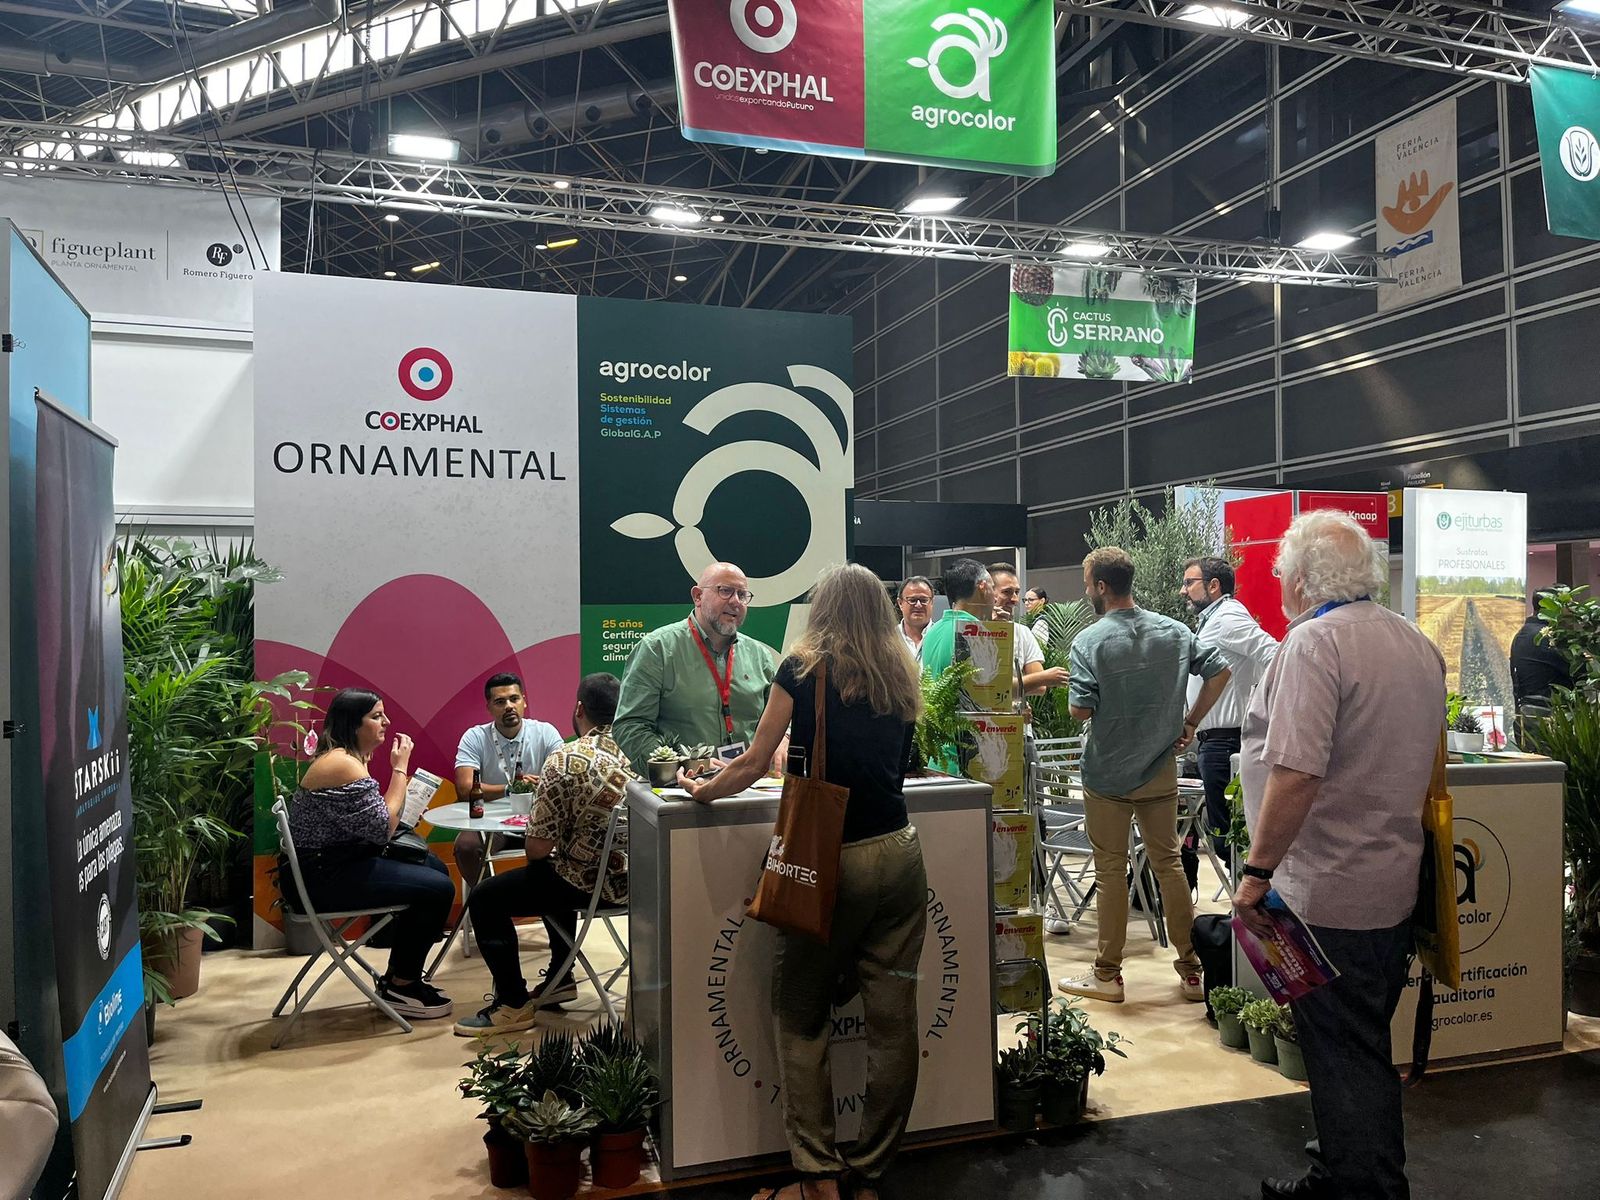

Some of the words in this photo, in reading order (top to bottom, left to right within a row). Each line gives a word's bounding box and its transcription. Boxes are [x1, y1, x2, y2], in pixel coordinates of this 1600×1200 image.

[693, 60, 834, 103] COEXPHAL
[911, 103, 1016, 132] agrocolor
[1396, 135, 1422, 152] FERIA
[1396, 137, 1439, 161] VALENCIA
[51, 236, 156, 262] figueplant
[51, 260, 82, 269] PLANTA
[84, 262, 138, 273] ORNAMENTAL
[183, 268, 218, 279] Romero
[1398, 265, 1425, 280] FERIA
[1398, 269, 1442, 289] VALENCIA
[1073, 311, 1112, 322] CACTUS
[1073, 323, 1165, 345] SERRANO
[599, 360, 712, 383] agrocolor
[600, 392, 672, 405] Sostenibilidad
[600, 404, 647, 415] Sistemas
[365, 410, 483, 434] COEXPHAL
[600, 414, 613, 424] de
[615, 414, 653, 427] gestión
[600, 428, 662, 439] GlobalG.A.P
[273, 441, 567, 481] ORNAMENTAL
[1438, 558, 1506, 570] PROFESIONALES
[602, 619, 617, 629] 25
[618, 619, 644, 629] años
[766, 857, 818, 884] BIHORTEC
[1457, 909, 1492, 925] color
[926, 887, 960, 1040] ORNAMENTAL
[1461, 962, 1528, 982] rtificación
[708, 917, 752, 1077] ORNAMENTAL
[1431, 1011, 1493, 1031] grocolor.es
